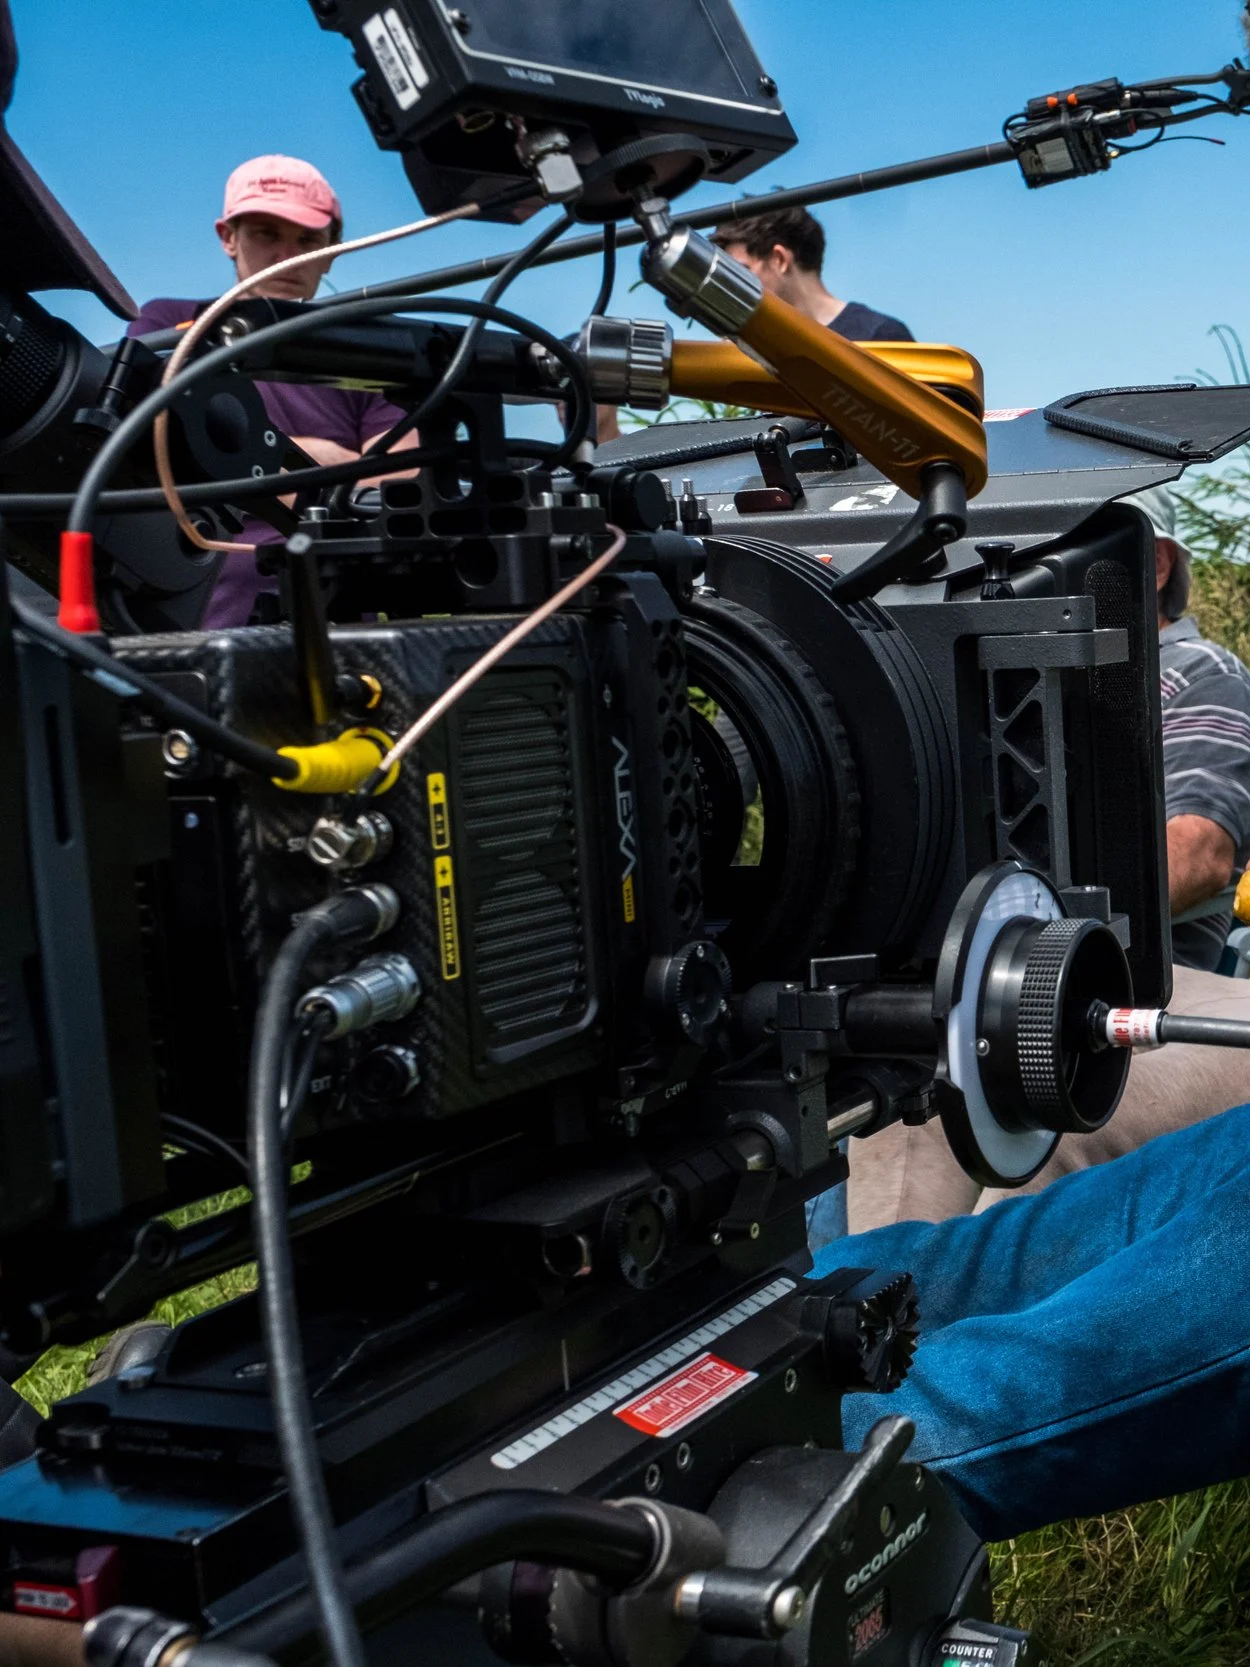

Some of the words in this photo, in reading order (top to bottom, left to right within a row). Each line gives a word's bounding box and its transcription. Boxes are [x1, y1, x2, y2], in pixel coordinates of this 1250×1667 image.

[611, 735, 637, 881] ALEXA
[443, 897, 457, 965] ARRIRAW
[941, 1643, 994, 1659] COUNTER
